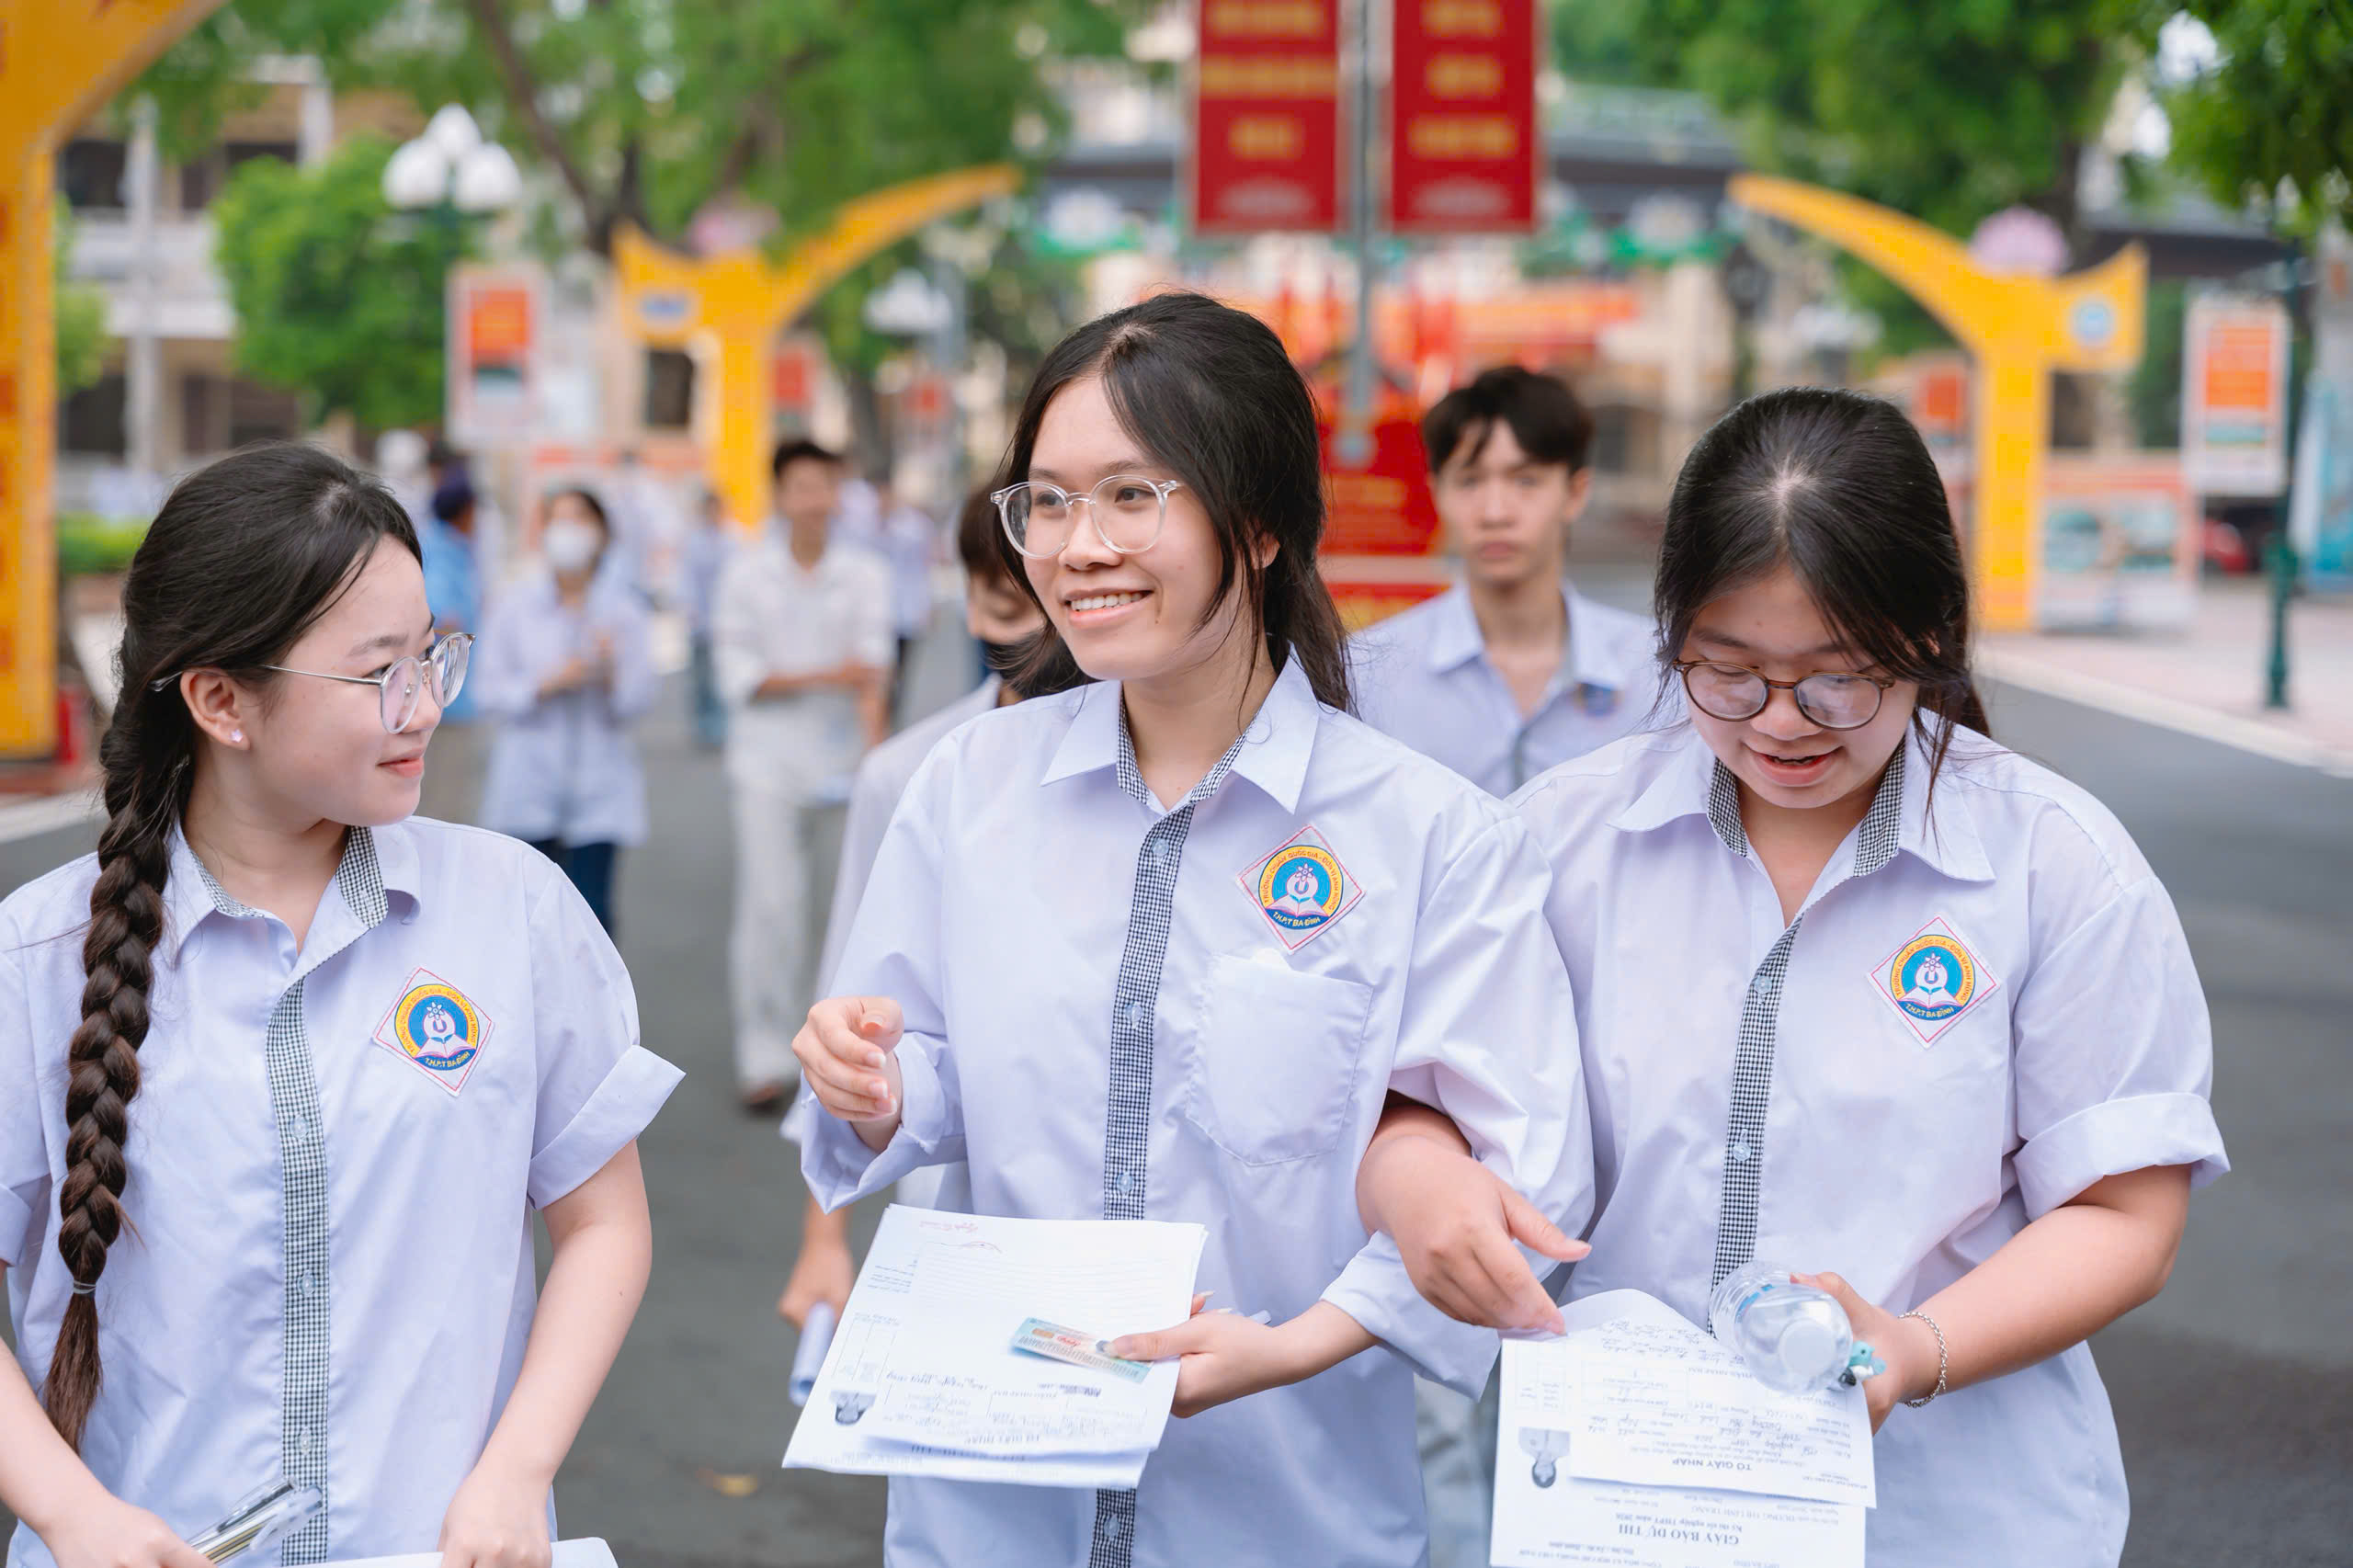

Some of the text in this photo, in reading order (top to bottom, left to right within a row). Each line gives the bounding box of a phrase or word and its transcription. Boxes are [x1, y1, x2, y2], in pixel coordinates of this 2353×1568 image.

[1288, 847, 1306, 858] QUỐC
[1307, 850, 1318, 858] GIA
[1619, 1524, 1642, 1536] THI
[1671, 1530, 1699, 1543] BÁO
